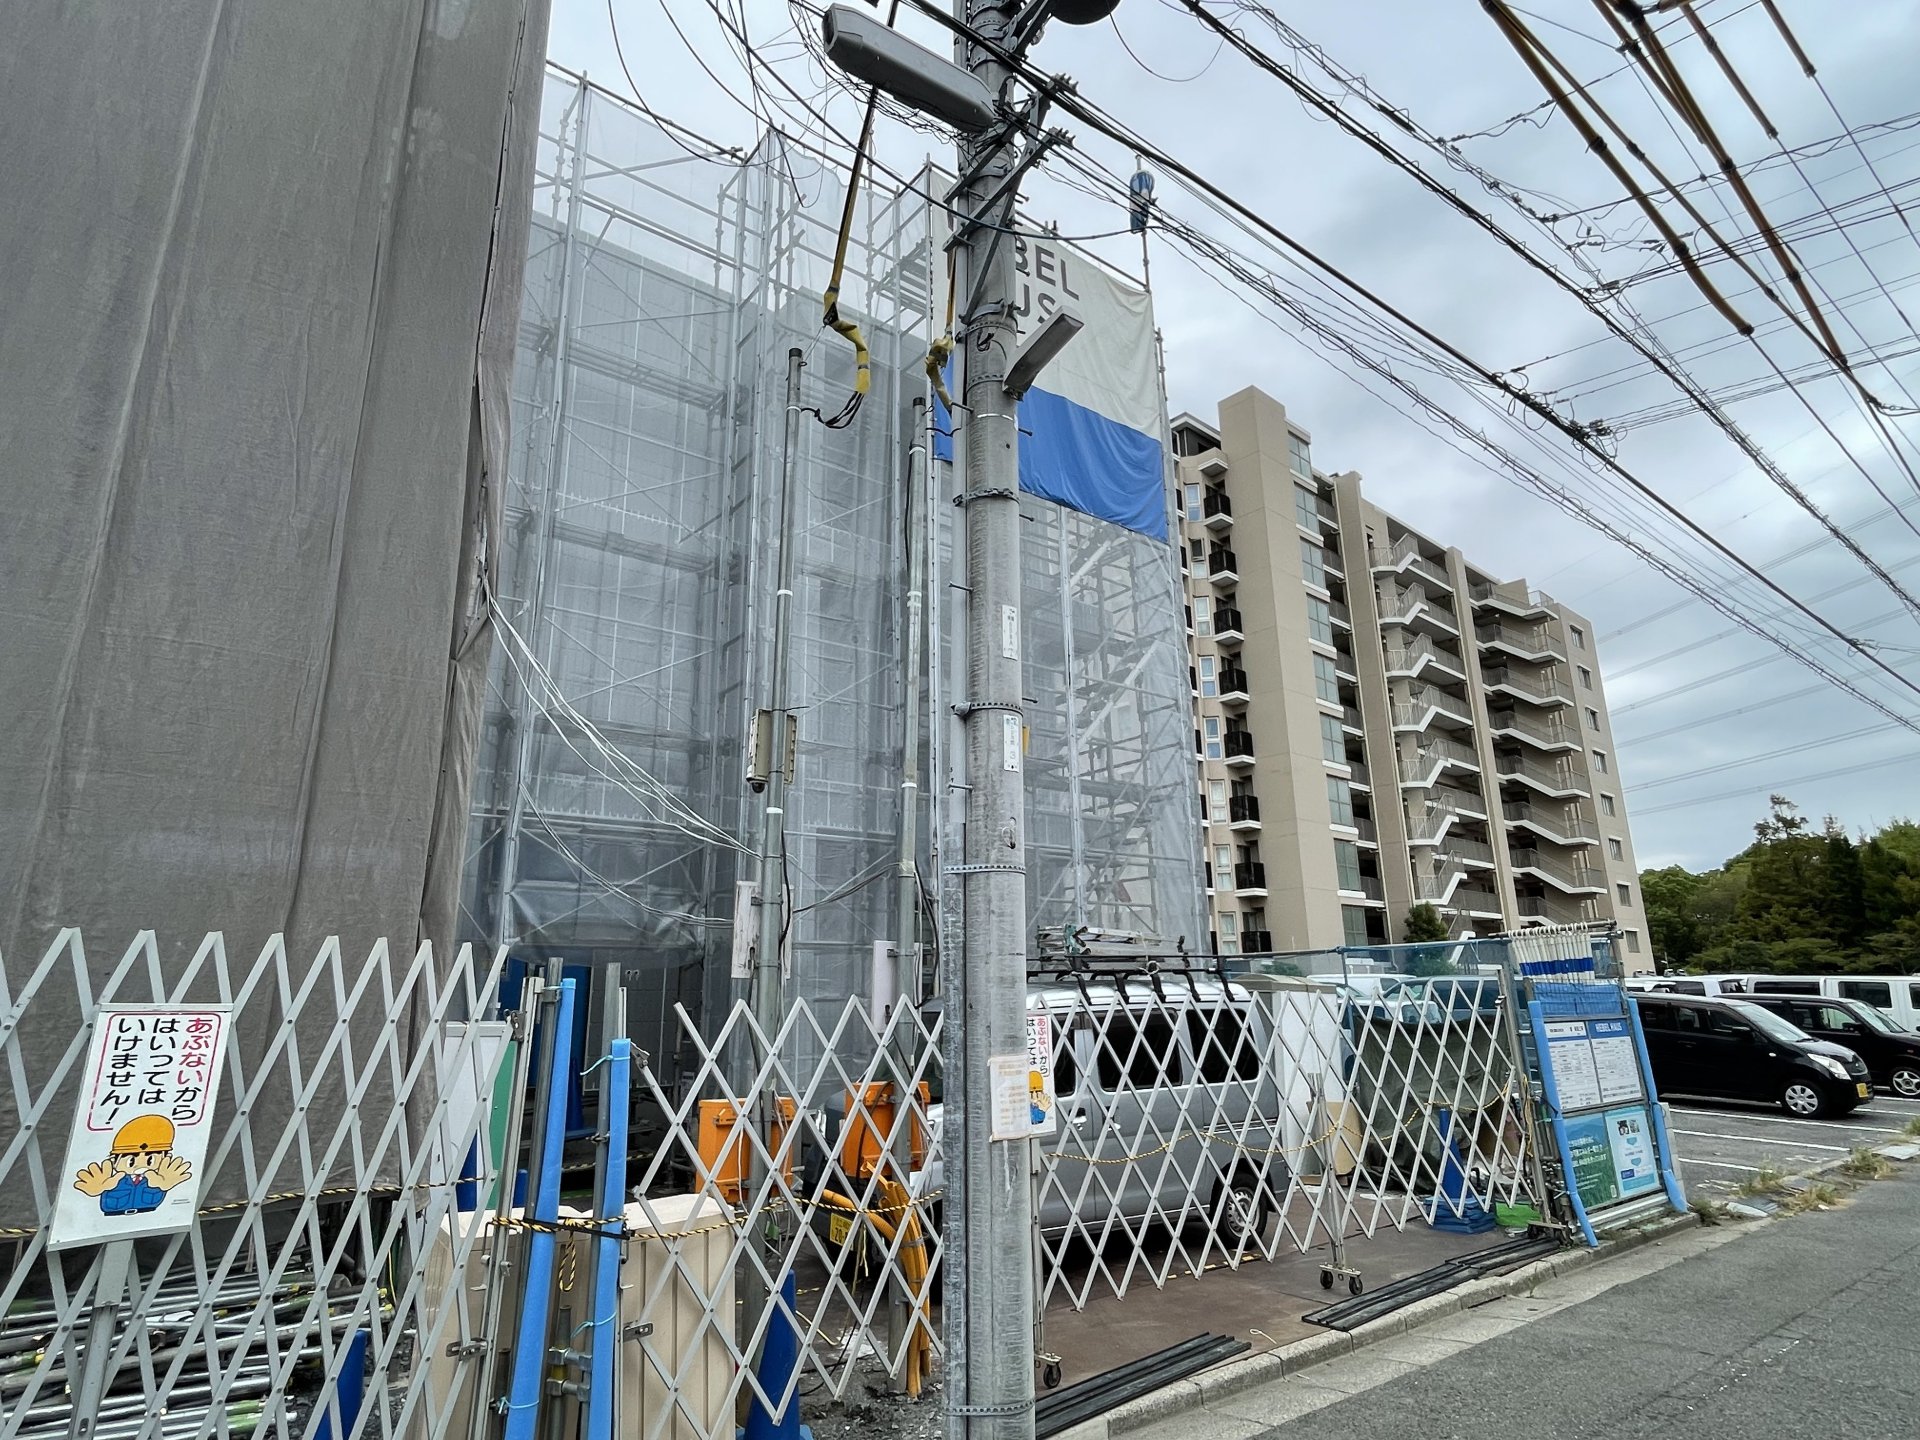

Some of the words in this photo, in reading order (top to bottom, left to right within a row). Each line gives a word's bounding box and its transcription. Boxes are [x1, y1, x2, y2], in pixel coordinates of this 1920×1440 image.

[138, 1017, 181, 1105] はいっては
[171, 1017, 214, 1121] あぶないから
[1037, 1017, 1048, 1075] あぶないから
